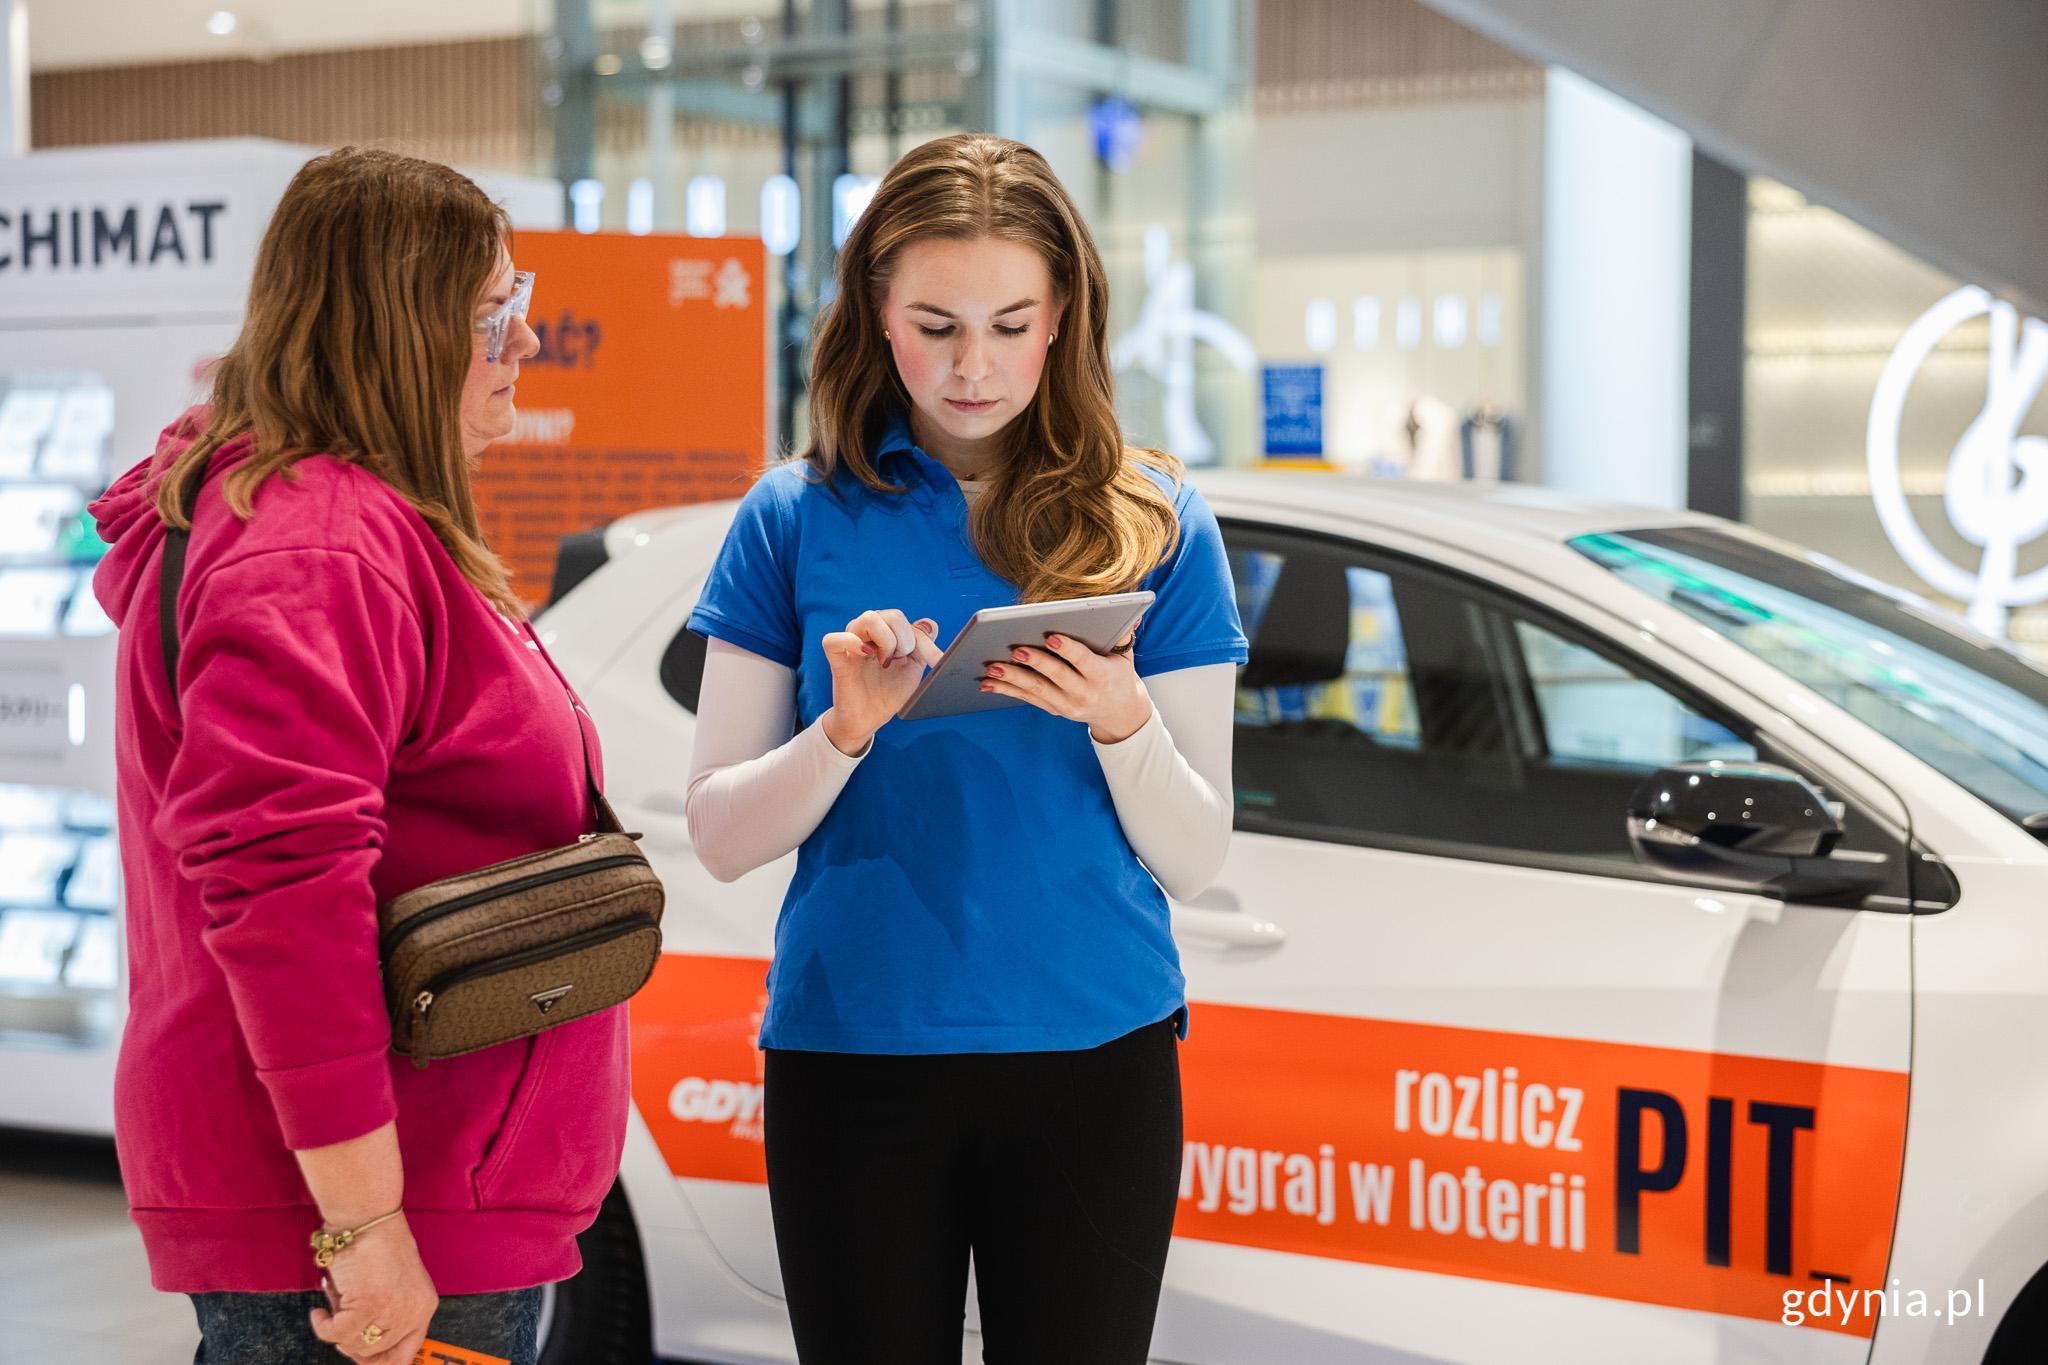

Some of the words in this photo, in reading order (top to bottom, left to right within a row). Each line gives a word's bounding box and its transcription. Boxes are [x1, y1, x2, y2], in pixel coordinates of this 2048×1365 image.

[668, 1077, 764, 1123] GDY
[1394, 1066, 1585, 1153] rozlicz
[1349, 1161, 1395, 1226] w
[1409, 1158, 1586, 1252] loterii
